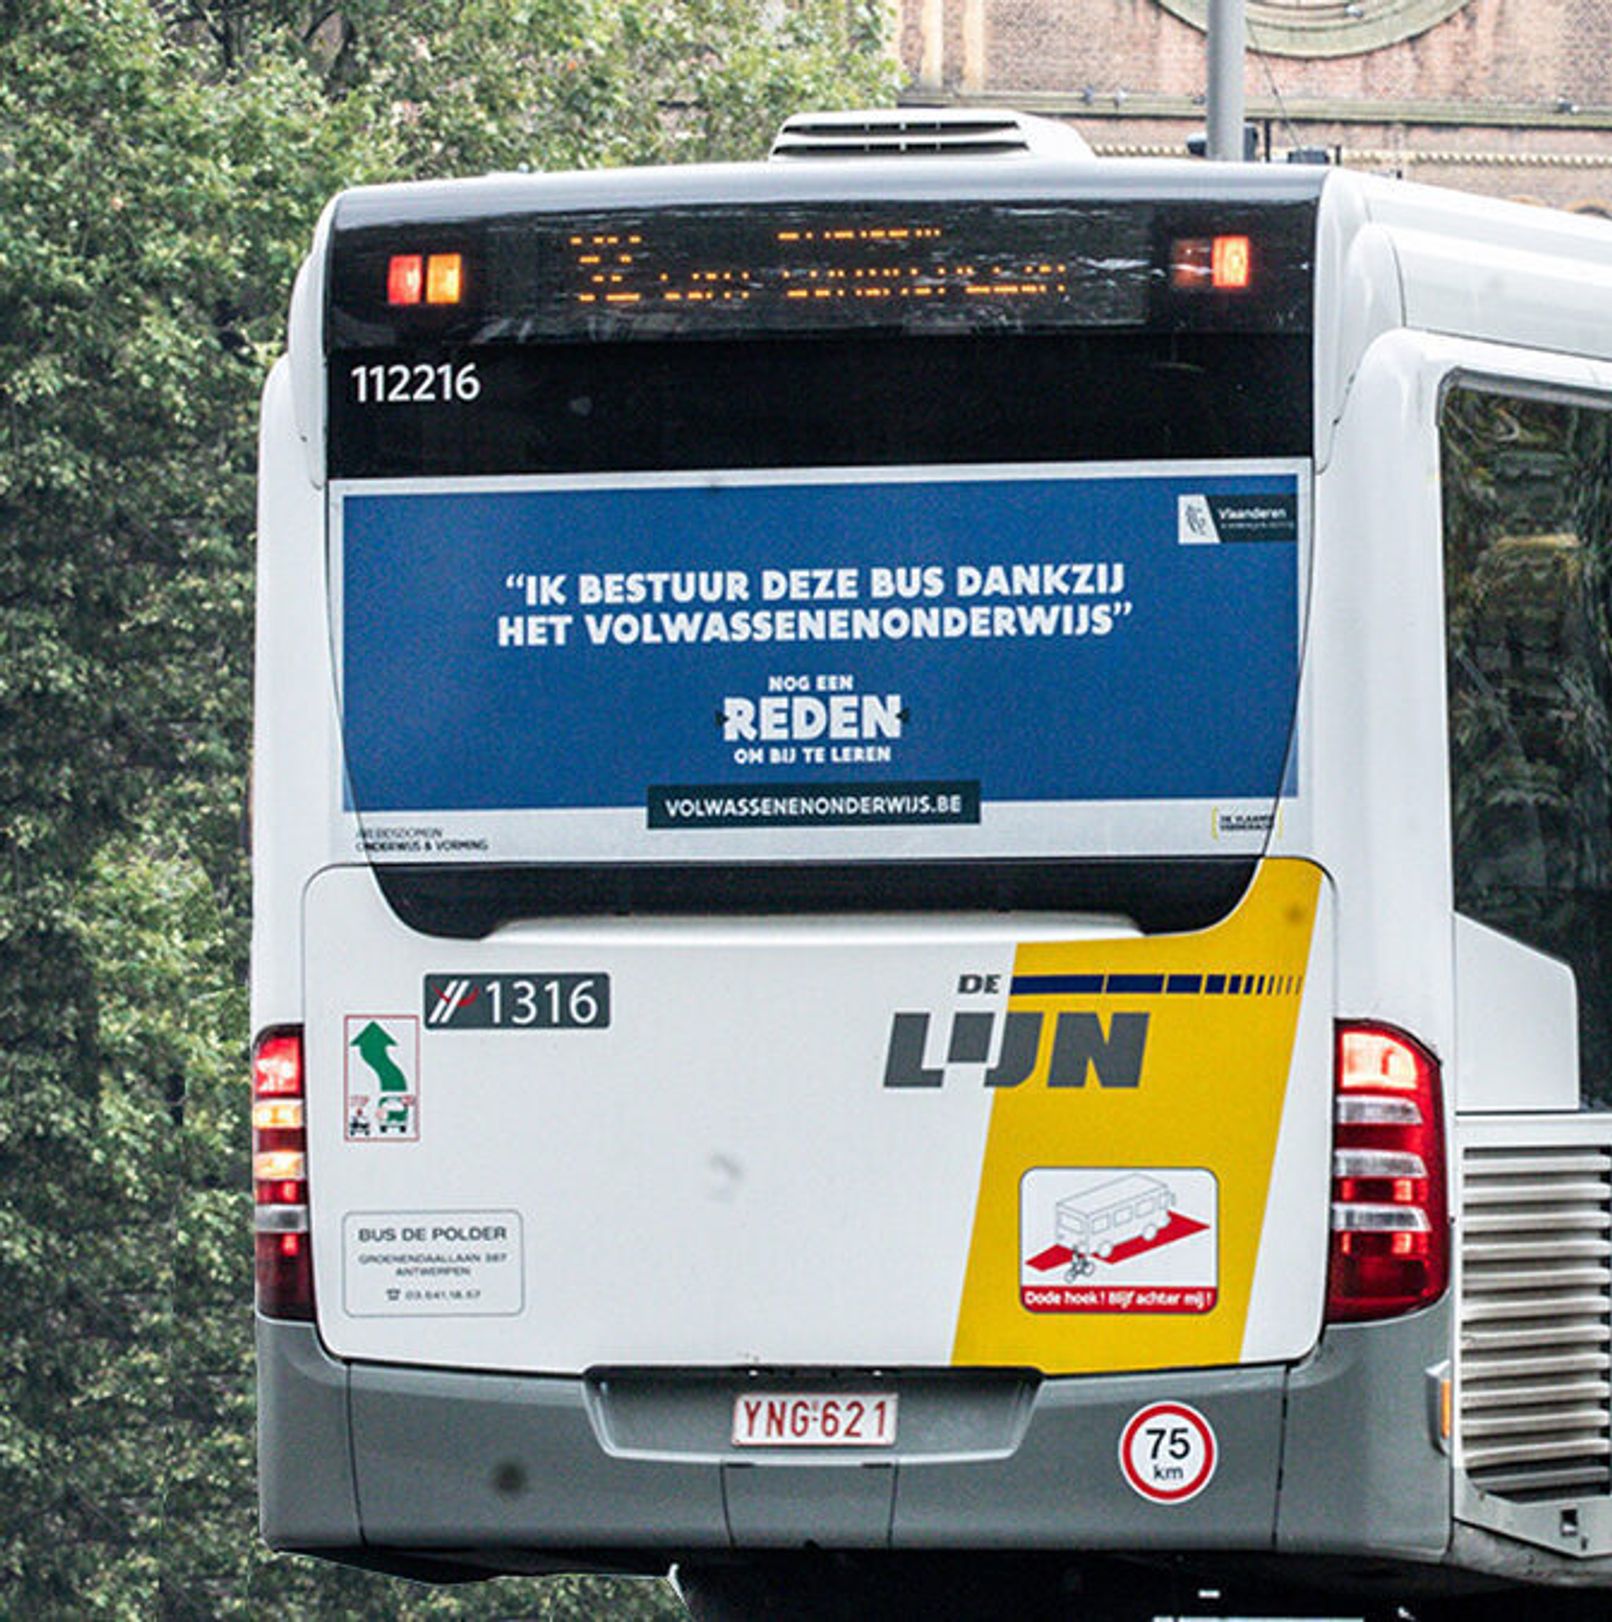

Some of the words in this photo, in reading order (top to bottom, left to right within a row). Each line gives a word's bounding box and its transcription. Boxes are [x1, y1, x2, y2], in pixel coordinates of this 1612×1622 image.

[351, 365, 481, 403] 112216
[579, 570, 750, 604] BESTUUR
[761, 568, 859, 601] DEZE
[870, 566, 945, 599] BUS
[957, 563, 1126, 597] DANKZIJ
[497, 614, 573, 648] HET
[768, 676, 810, 692] NOG
[816, 675, 854, 691] EEN
[723, 694, 904, 743] REDEN
[734, 748, 765, 765] OM
[769, 747, 798, 765] BIJ
[803, 747, 828, 764] TE
[832, 746, 892, 763] LEREN
[664, 795, 963, 819] VOLWASSENENONDERWIJS.BE
[957, 974, 1000, 994] DE
[486, 980, 600, 1025] 1316
[358, 1228, 397, 1242] BUS
[402, 1227, 427, 1241] DE
[432, 1226, 507, 1241] POLDER
[395, 1266, 471, 1277] ANTWERPEN
[1025, 1292, 1061, 1306] Dode
[1136, 1291, 1181, 1305] achter
[1146, 1428, 1190, 1459] 75
[1154, 1464, 1184, 1481] km
